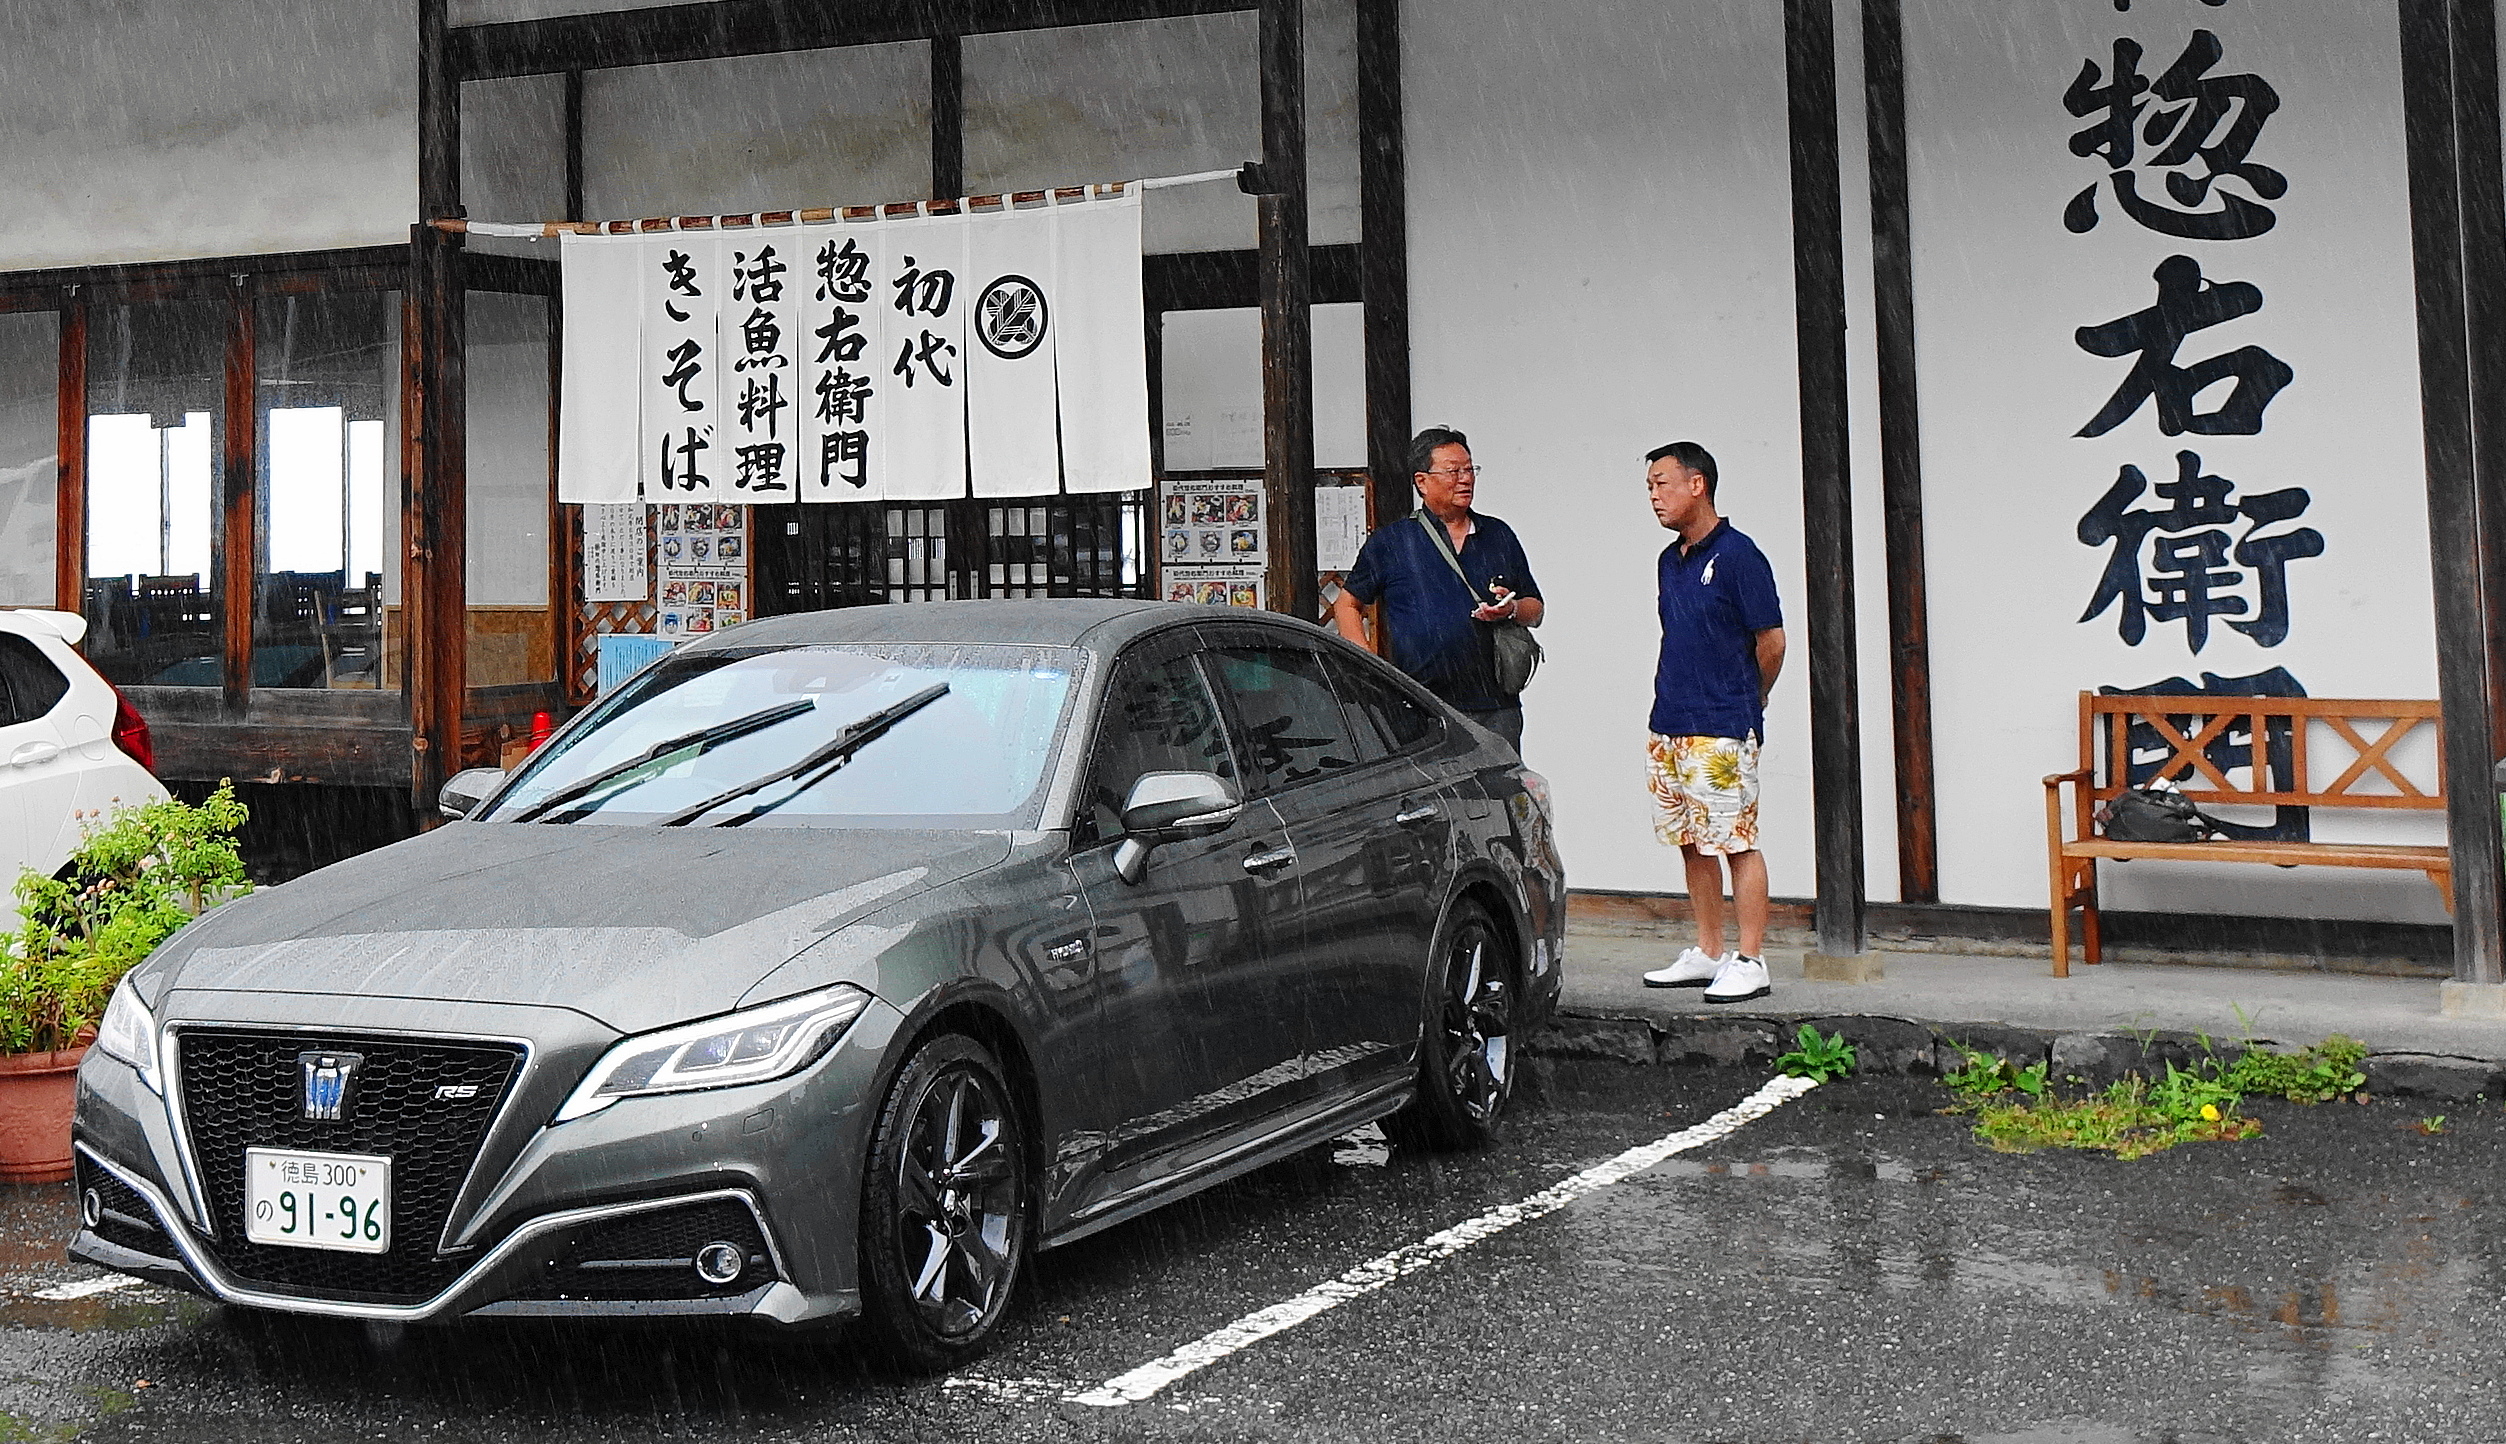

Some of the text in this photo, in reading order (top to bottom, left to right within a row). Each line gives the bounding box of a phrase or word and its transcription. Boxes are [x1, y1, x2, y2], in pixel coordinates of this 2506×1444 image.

[662, 249, 714, 491] きそば
[733, 243, 789, 493] 活魚料理
[815, 237, 874, 489] 惣右衛門
[893, 254, 956, 389] 初代
[2063, 0, 2324, 866] 惣右衛門
[281, 1160, 357, 1187] 徳島 300
[435, 1085, 478, 1099] RS
[256, 1191, 381, 1241] の 91-96
